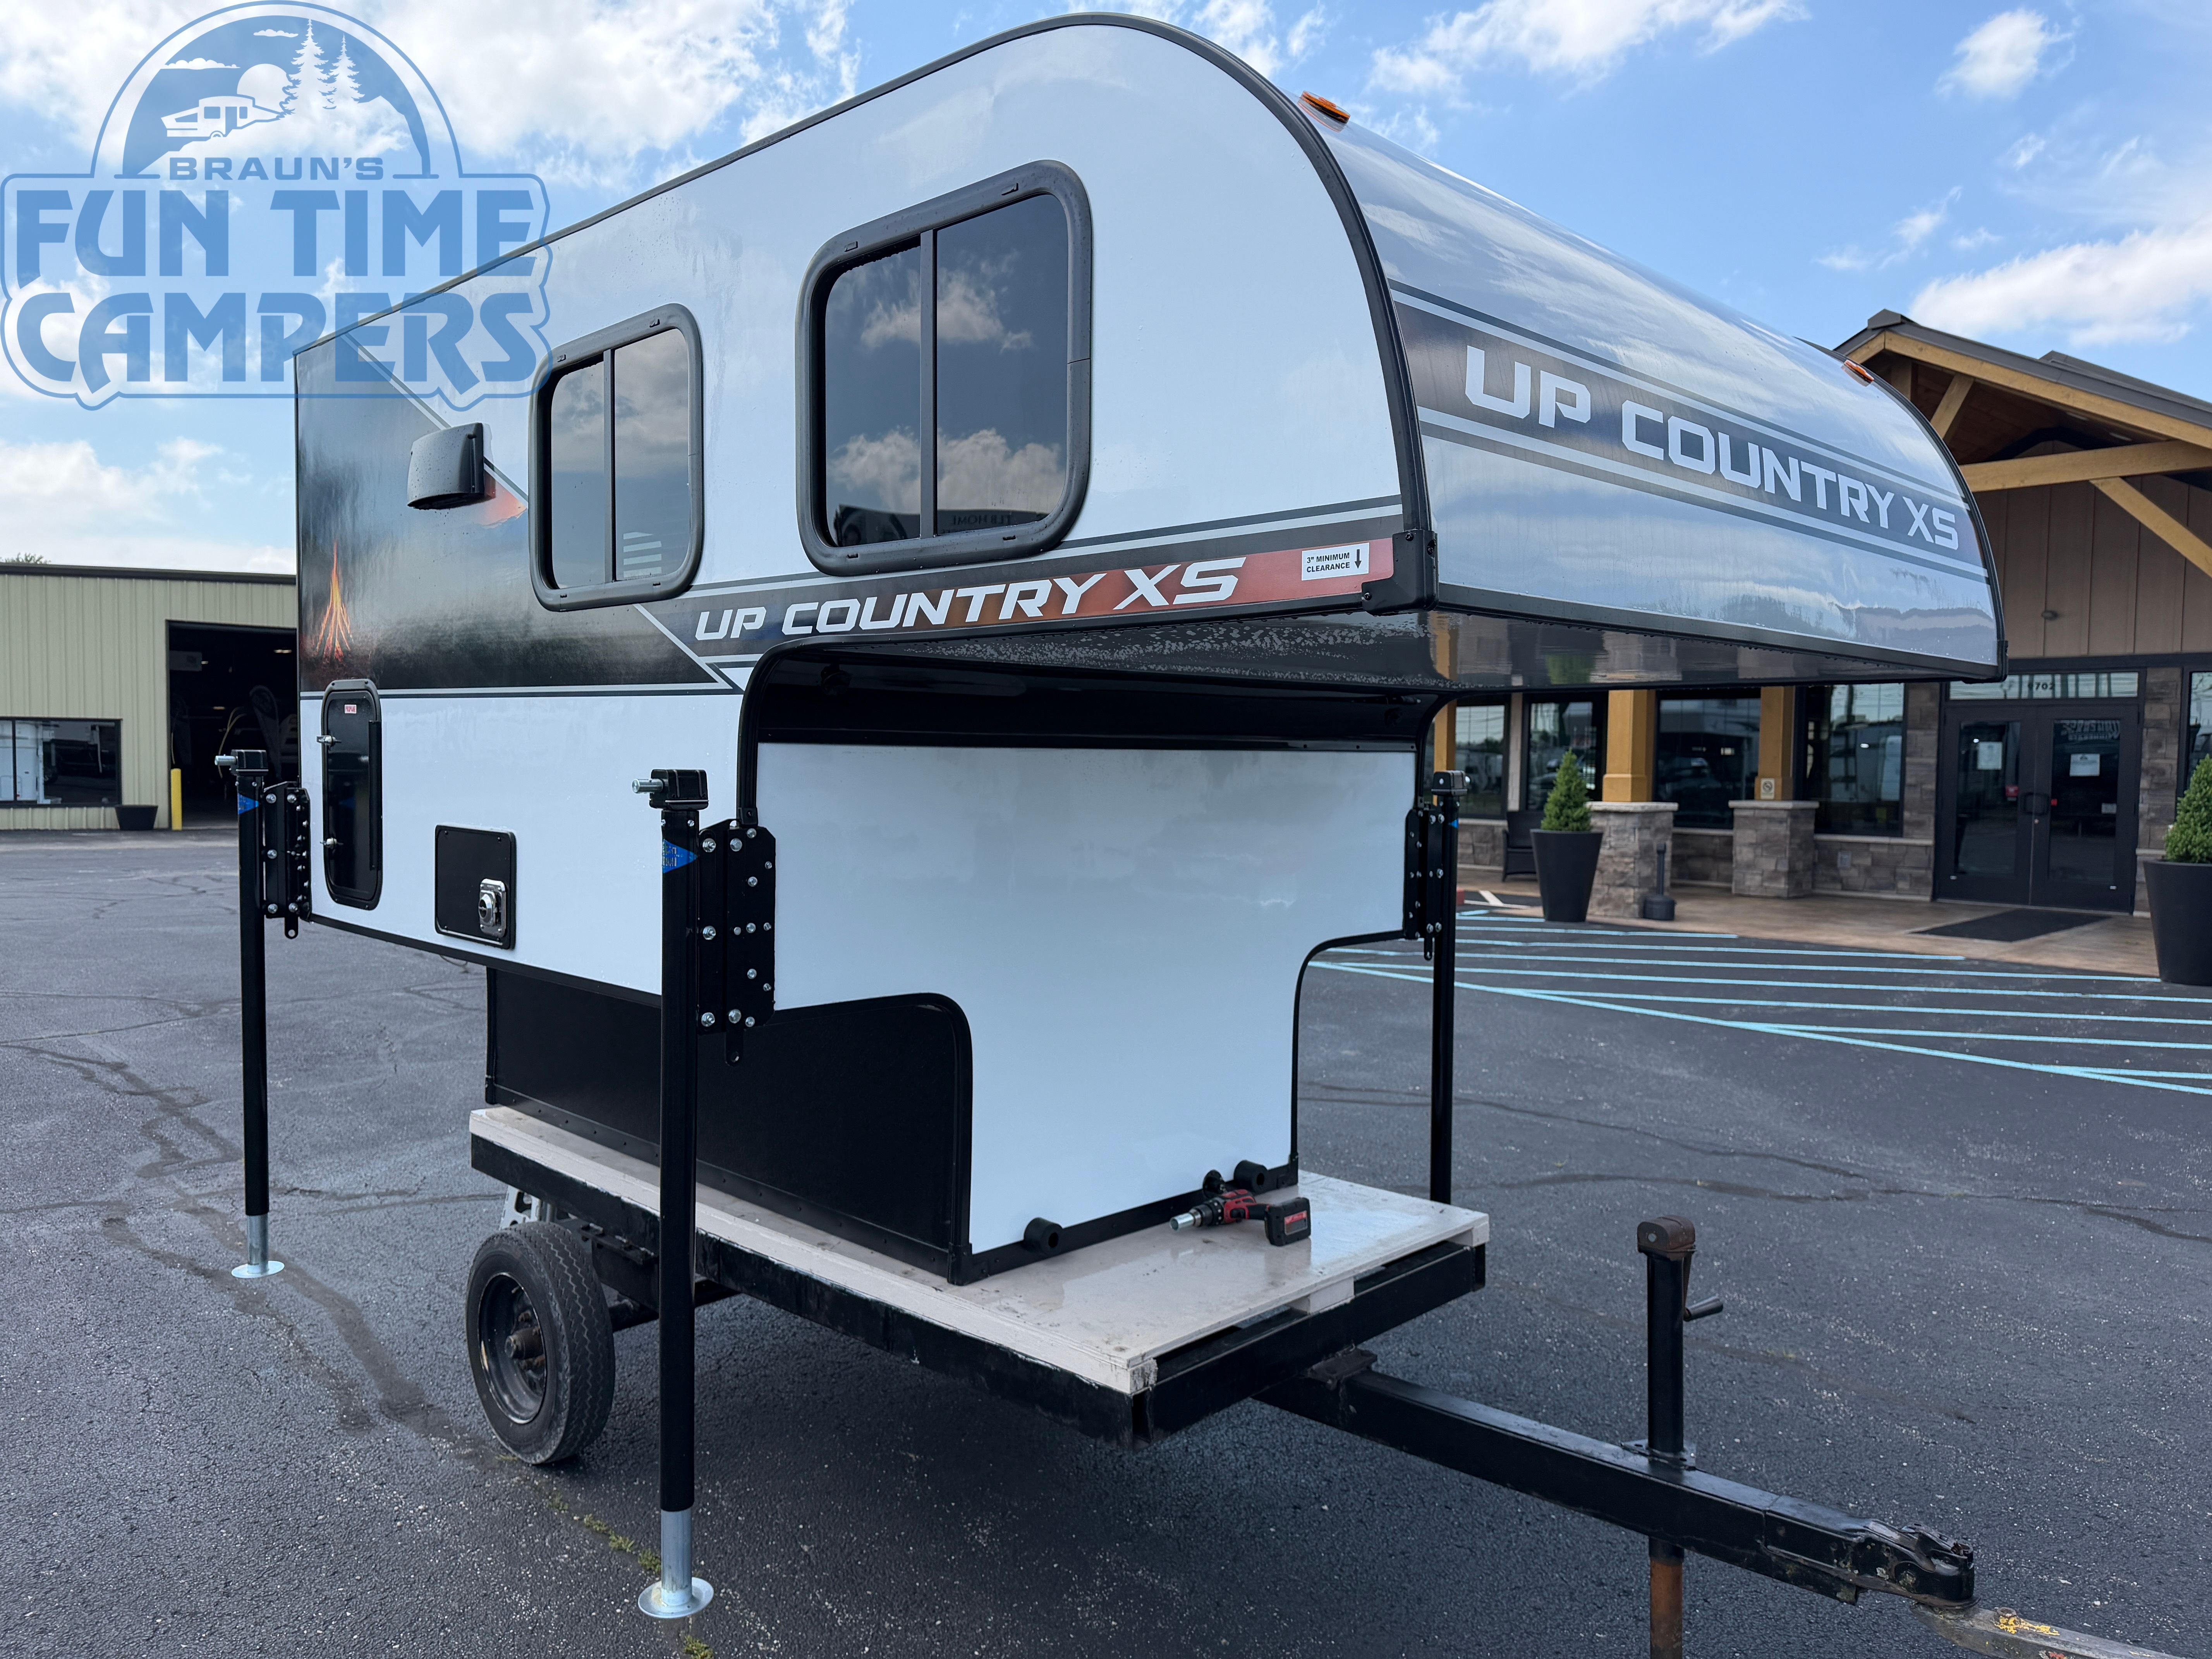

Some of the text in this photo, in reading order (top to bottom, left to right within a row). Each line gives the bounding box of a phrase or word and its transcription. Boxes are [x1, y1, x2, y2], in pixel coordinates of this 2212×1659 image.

[1465, 345, 1959, 550] UP COUNTRY XS
[1306, 562, 1350, 573] CLEARANCE
[1316, 552, 1350, 563] MINIMUM
[695, 557, 1246, 641] UP COUNTRY XS
